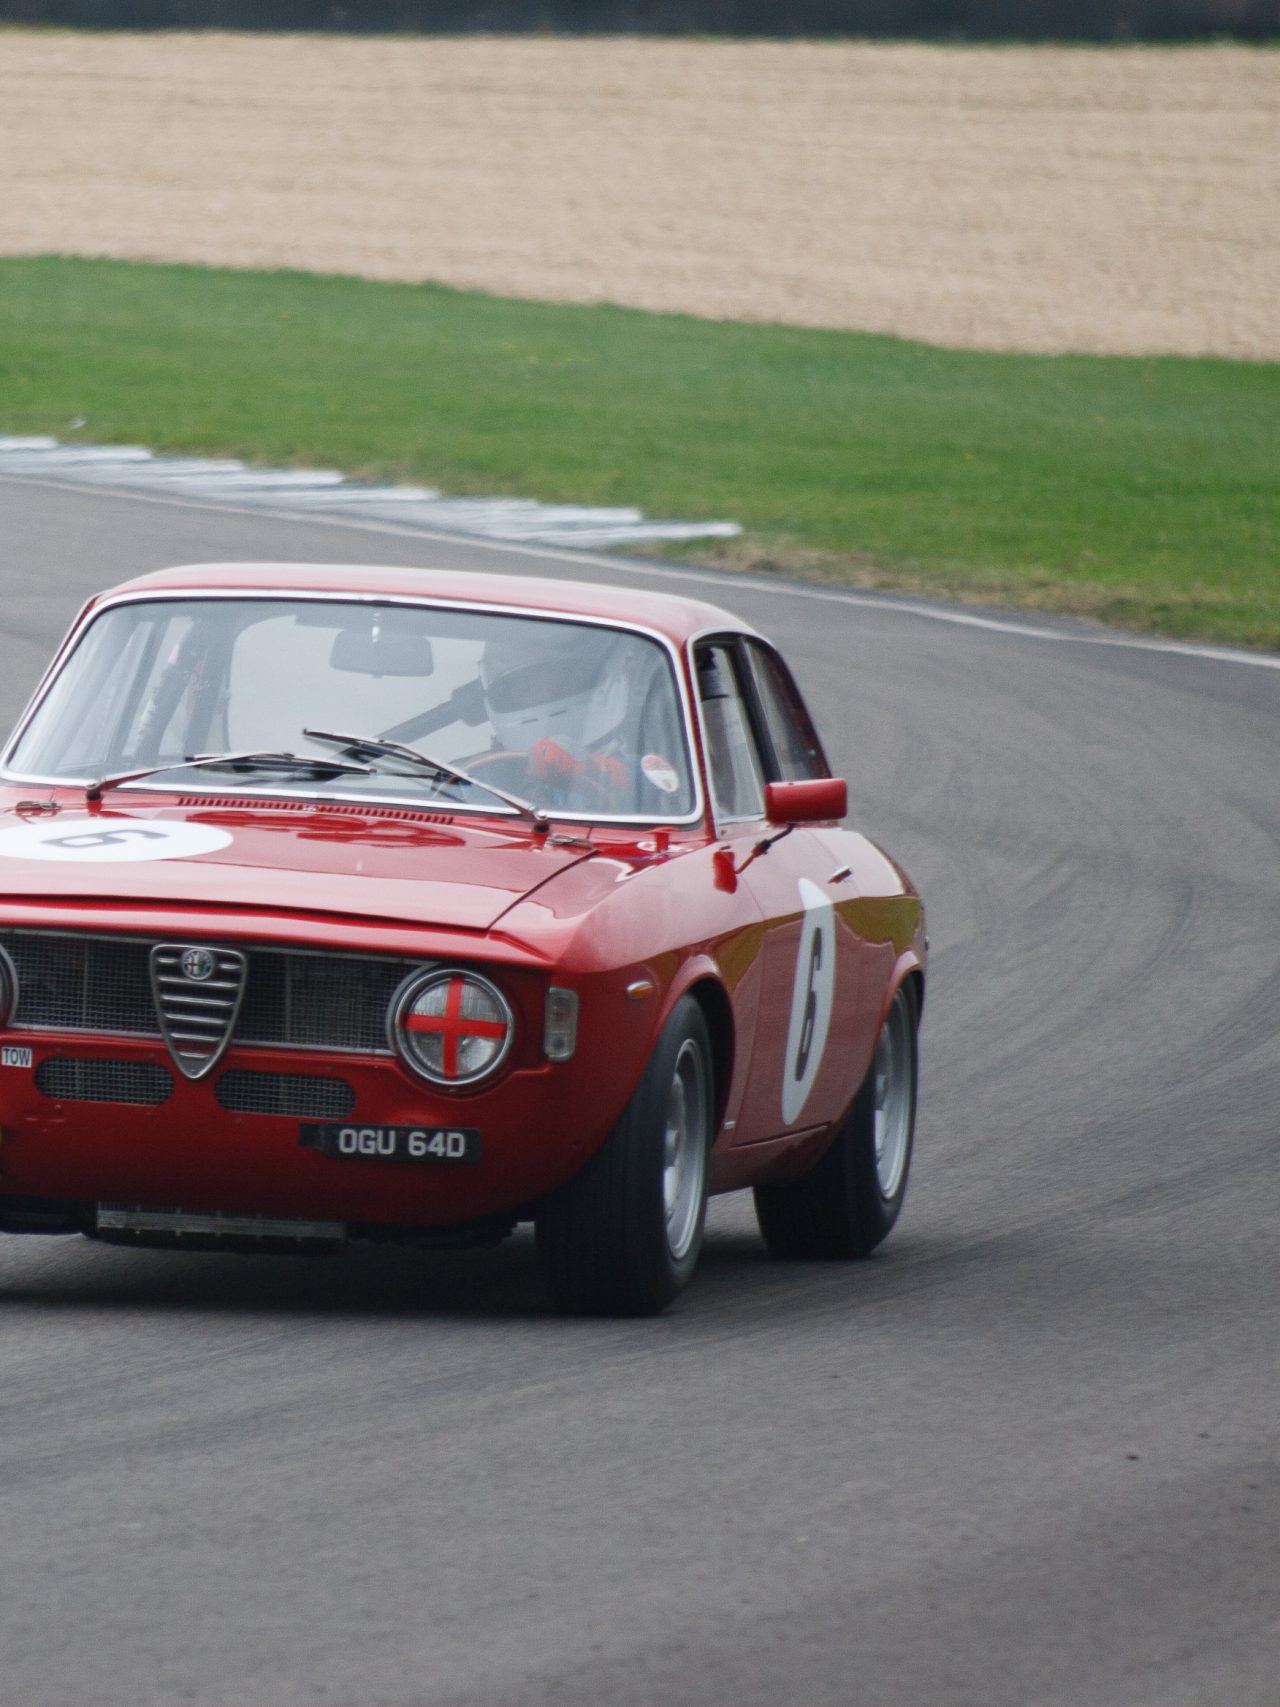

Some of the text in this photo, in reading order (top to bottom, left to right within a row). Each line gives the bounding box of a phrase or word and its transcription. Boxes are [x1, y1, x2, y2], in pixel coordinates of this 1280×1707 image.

[40, 829, 169, 848] 6
[795, 927, 822, 1082] 6
[2, 1047, 31, 1066] TOW
[338, 1128, 465, 1158] OGU 64D
